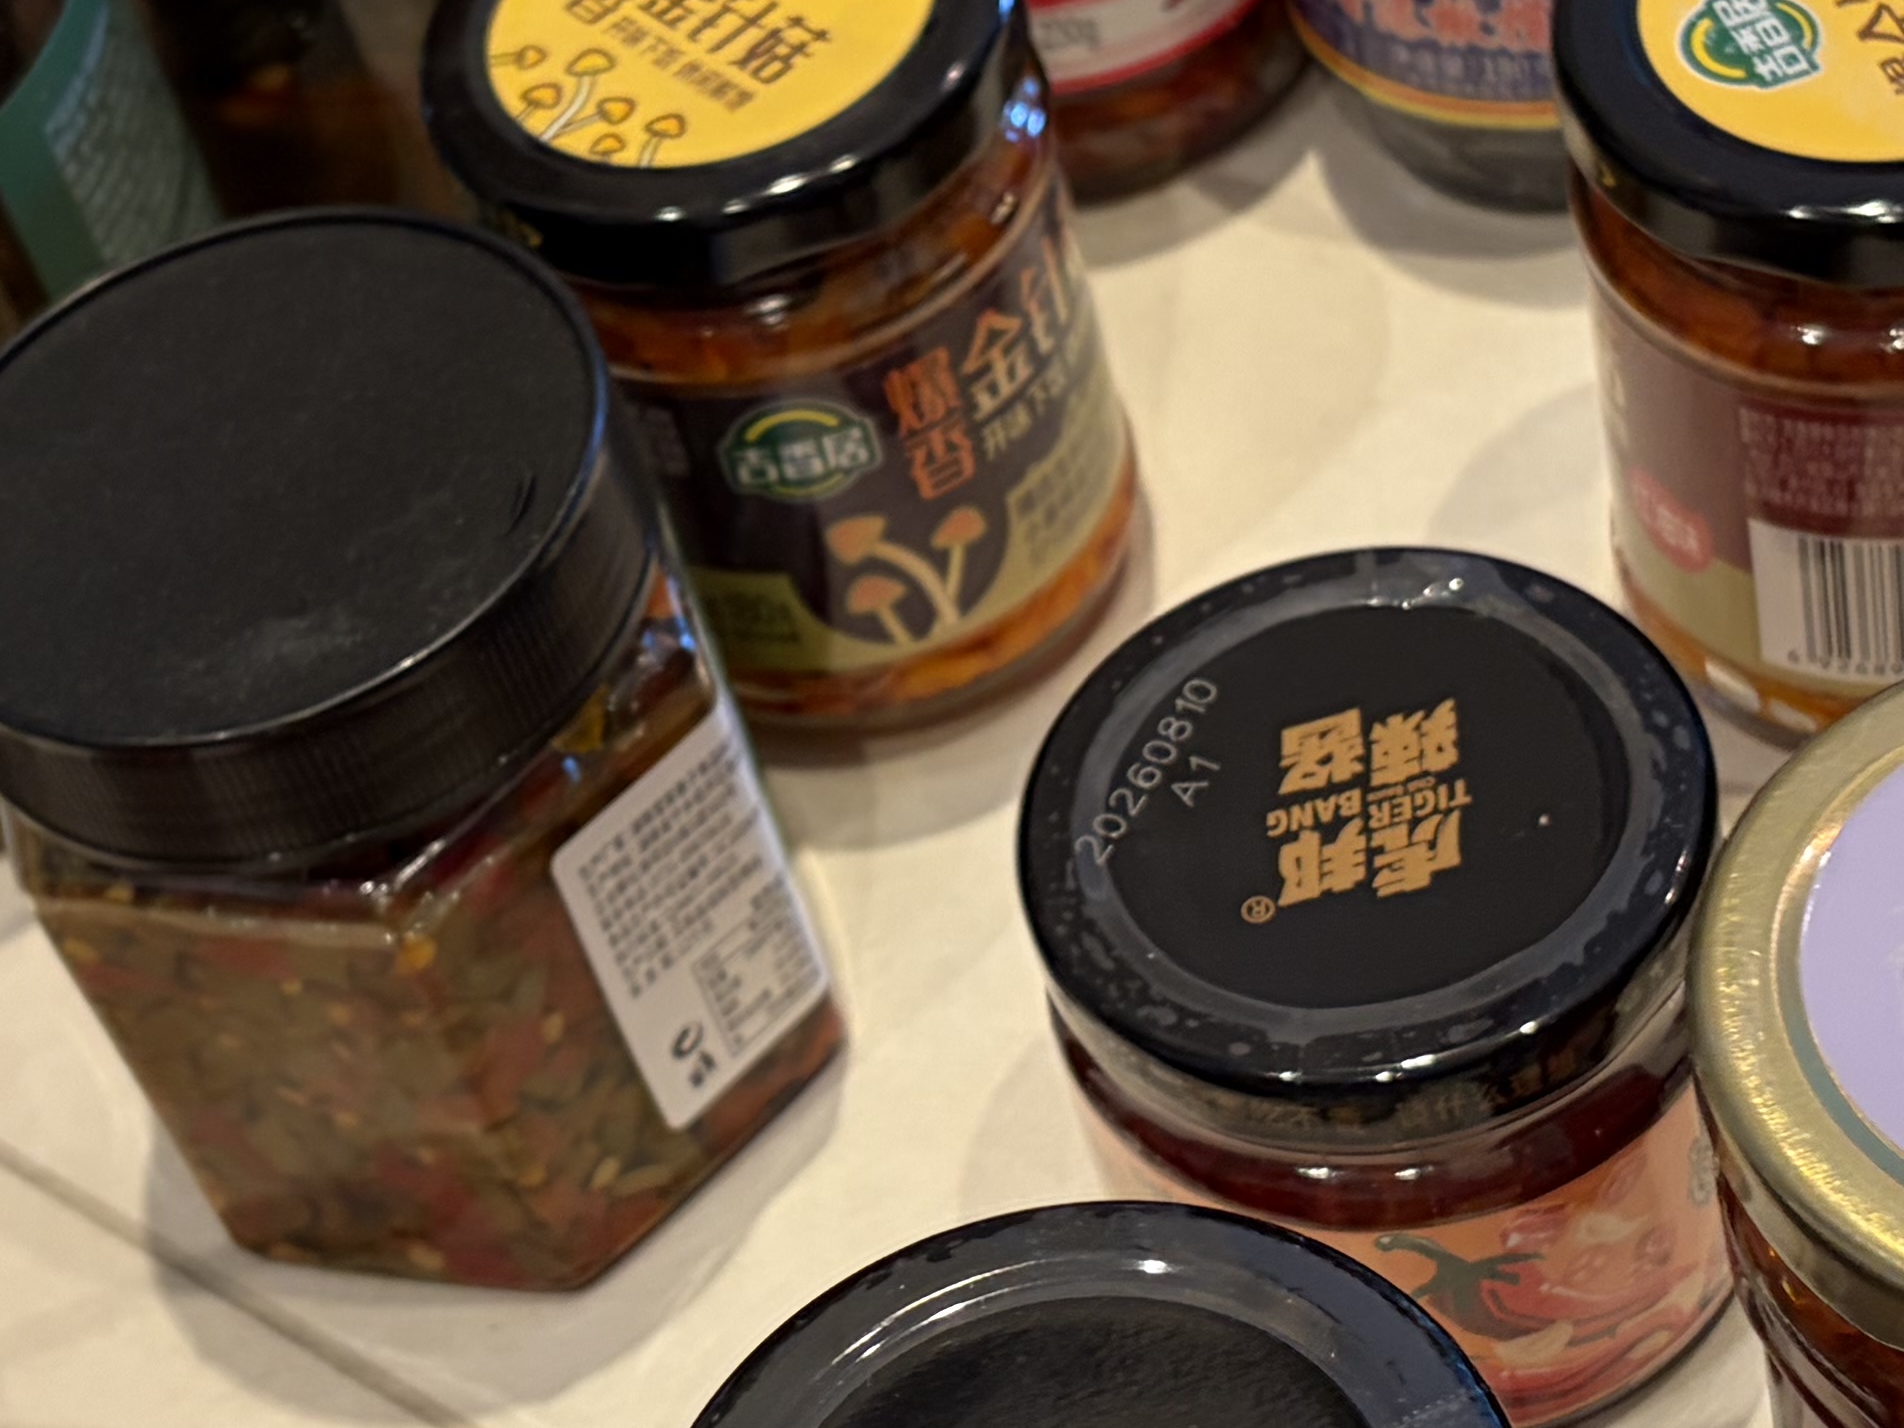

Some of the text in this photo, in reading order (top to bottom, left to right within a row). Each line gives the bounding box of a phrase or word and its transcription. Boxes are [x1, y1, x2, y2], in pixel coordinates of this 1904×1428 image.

[1073, 676, 1219, 864] 20260810
[1170, 755, 1222, 809] A1
[1265, 778, 1474, 837] TIGER BANG
